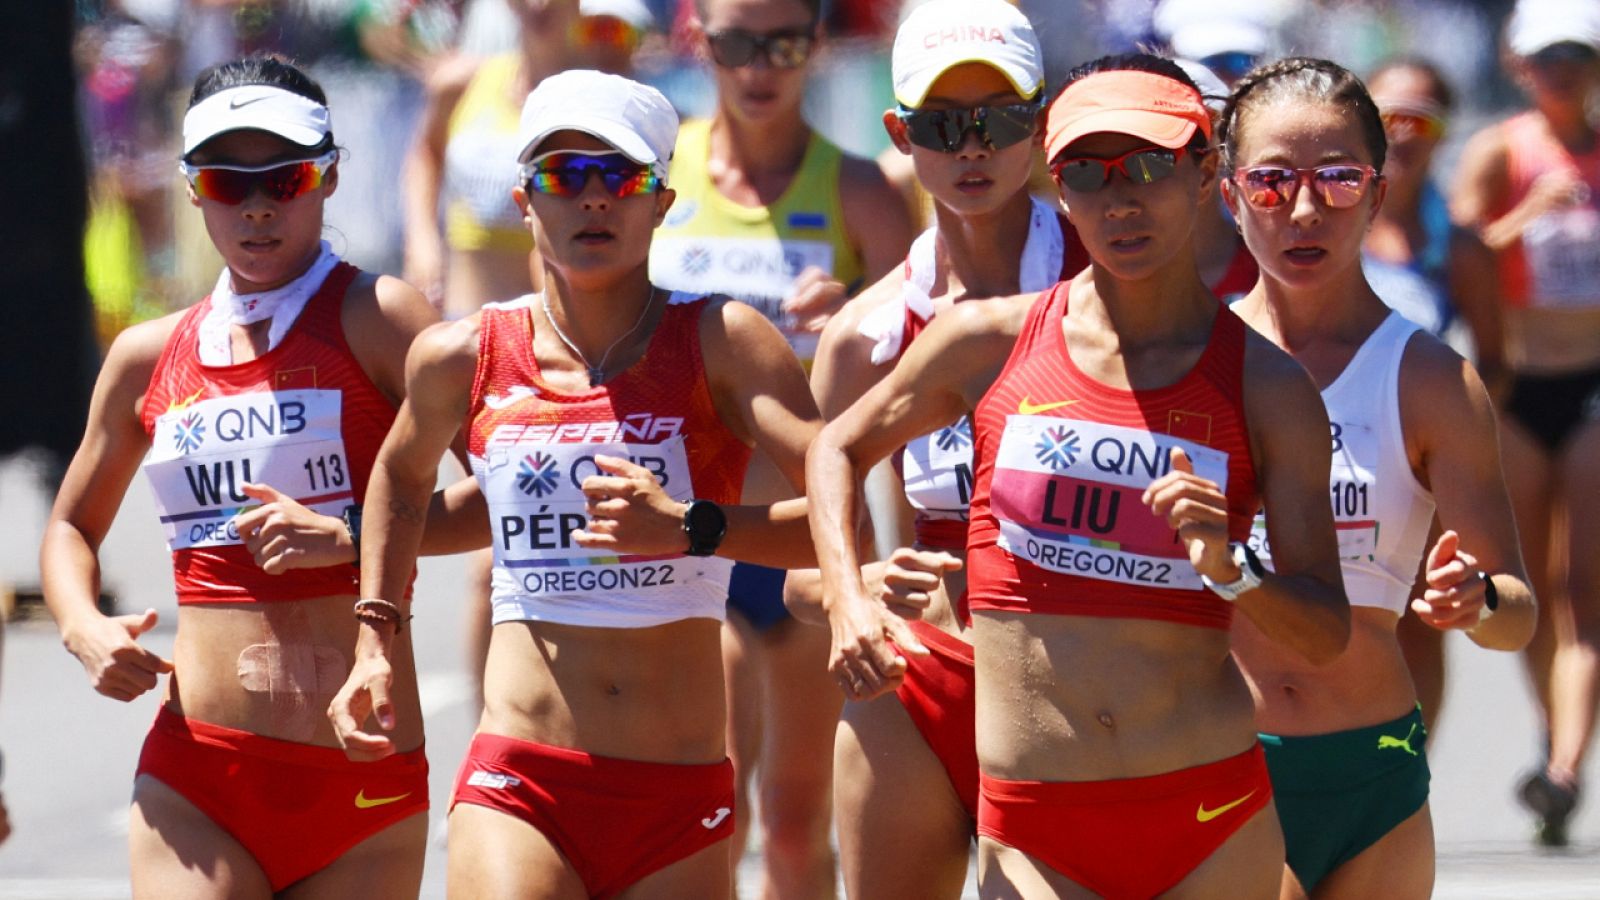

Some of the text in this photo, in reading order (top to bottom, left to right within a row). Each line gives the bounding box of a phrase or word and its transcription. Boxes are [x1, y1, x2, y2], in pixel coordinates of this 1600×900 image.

[924, 25, 1007, 49] CHINA
[215, 401, 306, 442] QNB
[486, 412, 685, 448] ESPAÑA
[184, 453, 345, 506] WU 113
[1041, 480, 1121, 534] LIU
[1332, 481, 1368, 516] 101
[189, 520, 241, 543] OREG
[501, 505, 588, 551] PÉR
[523, 564, 675, 594] OREGON22
[1027, 539, 1172, 584] OREGON22
[466, 770, 521, 790] ESP
